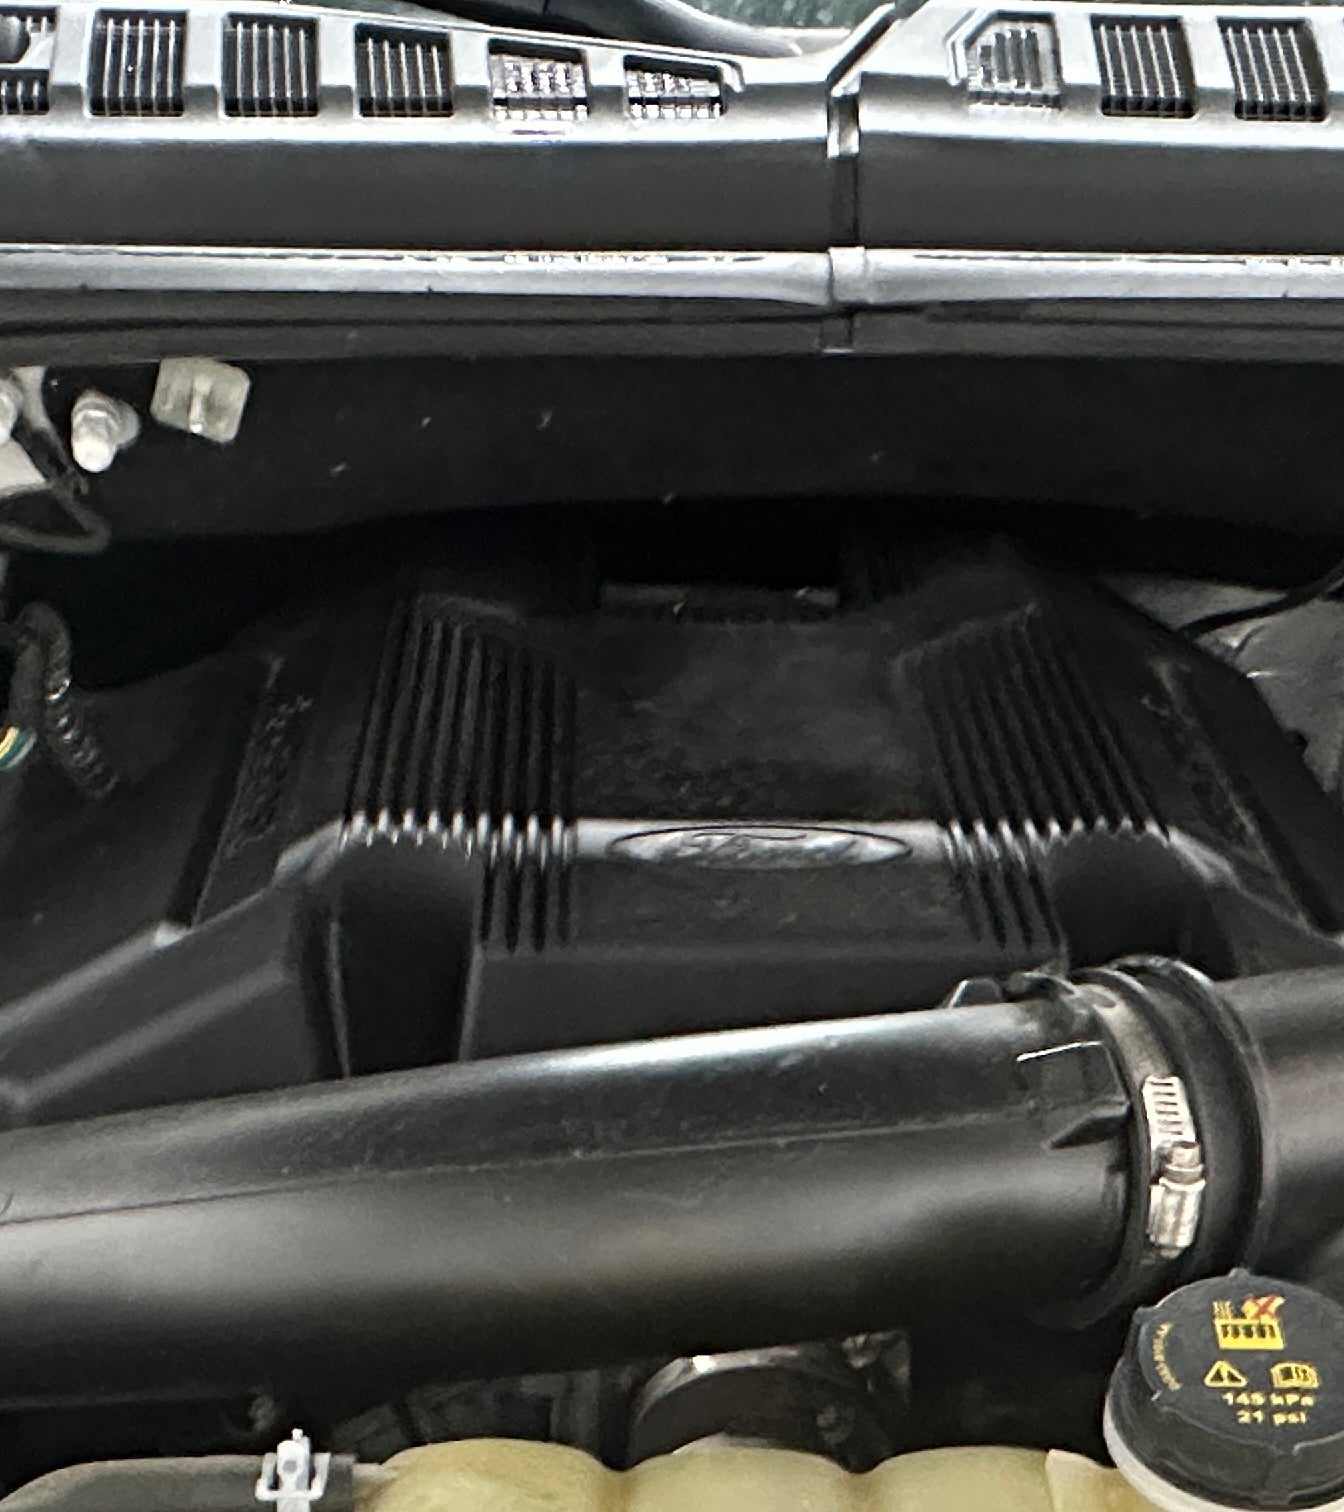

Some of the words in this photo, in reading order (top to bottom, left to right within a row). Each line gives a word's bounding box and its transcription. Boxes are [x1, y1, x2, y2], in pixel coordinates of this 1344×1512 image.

[1269, 1391, 1315, 1406] kPa
[1236, 1409, 1264, 1424] 21
[1272, 1411, 1307, 1426] psi
